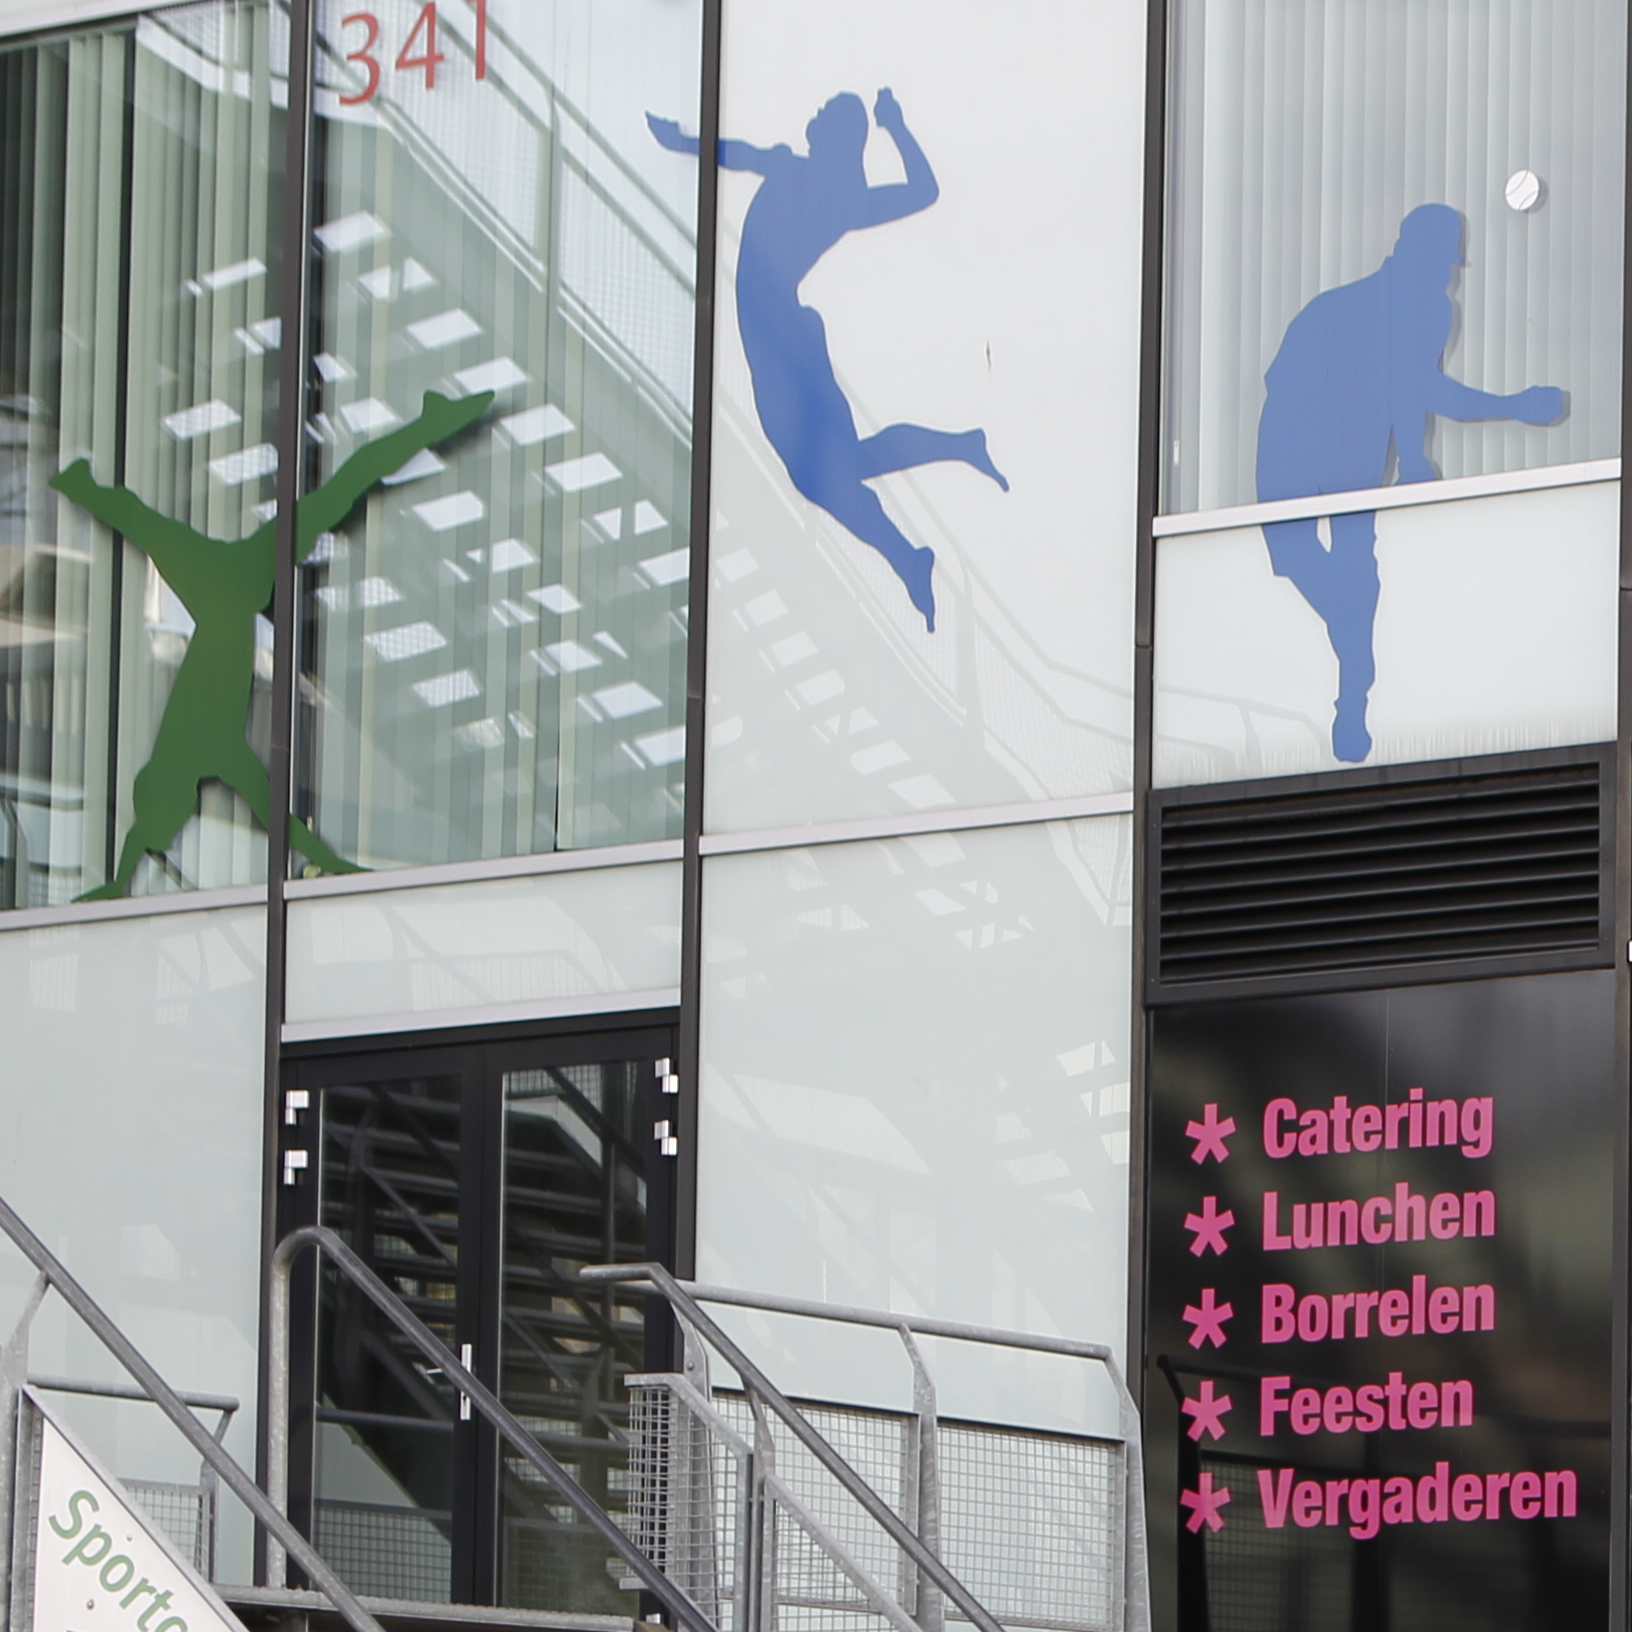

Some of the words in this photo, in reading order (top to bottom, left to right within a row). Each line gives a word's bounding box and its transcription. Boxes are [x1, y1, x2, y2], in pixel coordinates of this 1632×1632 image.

[339, 0, 487, 106] 341
[1262, 1087, 1494, 1159] Catering
[1262, 1182, 1495, 1251] Lunchen
[1261, 1275, 1495, 1344] Borrelen
[1260, 1372, 1474, 1437] Feesten
[1257, 1461, 1578, 1540] Vergaderen
